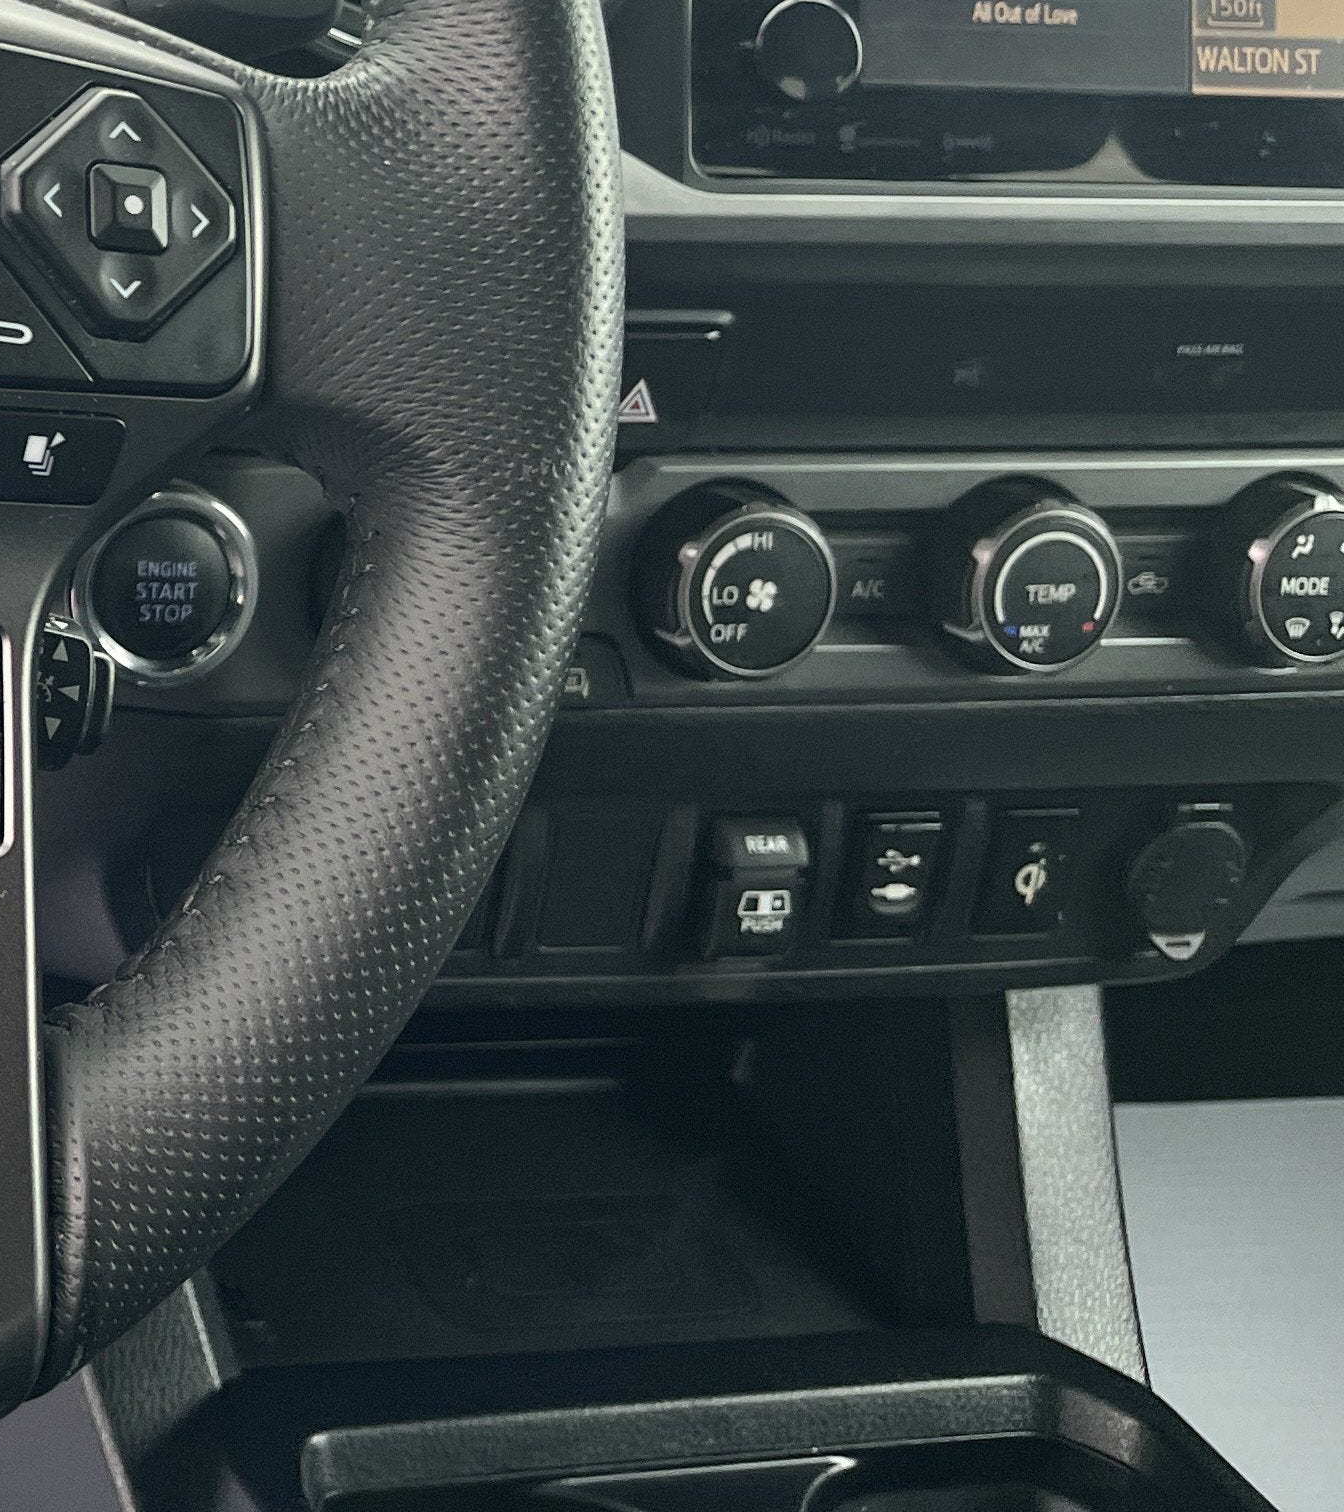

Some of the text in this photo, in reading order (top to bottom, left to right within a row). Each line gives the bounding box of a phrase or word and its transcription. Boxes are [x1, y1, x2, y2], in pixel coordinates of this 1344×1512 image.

[972, 0, 1078, 25] All Out of Love
[1197, 45, 1321, 75] WALTON ST
[752, 531, 774, 551] HI
[137, 560, 197, 577] ENGINE
[135, 582, 198, 601] START
[712, 585, 739, 606] LO
[1026, 584, 1076, 605] TEMP
[1280, 576, 1330, 596] MODE
[139, 604, 193, 622] STOP
[710, 623, 749, 644] OFF
[1019, 624, 1050, 638] MAX
[744, 835, 791, 855] REAR
